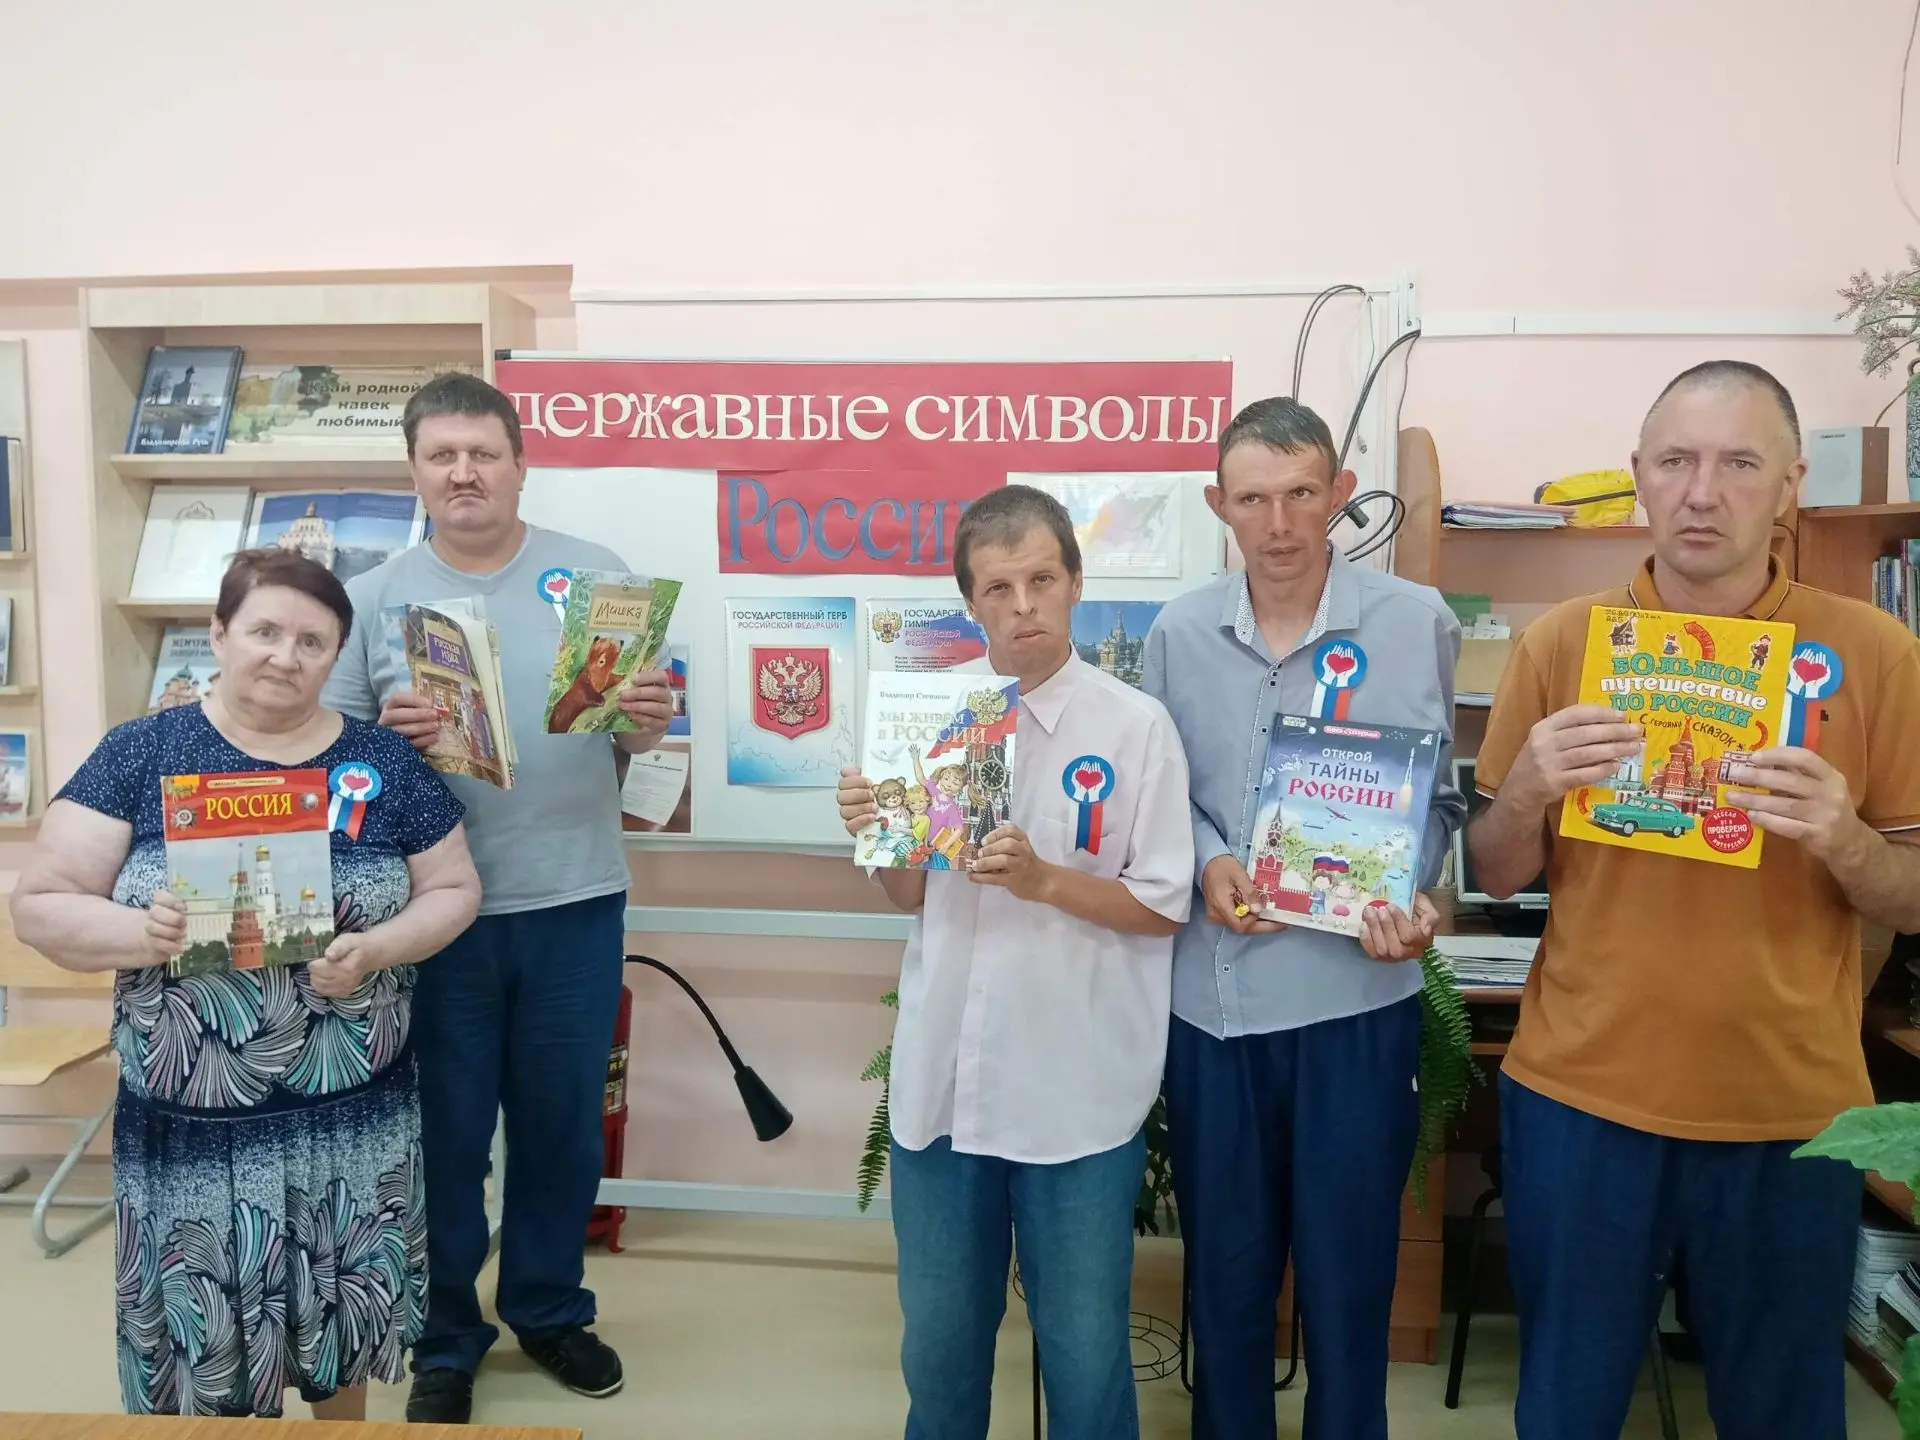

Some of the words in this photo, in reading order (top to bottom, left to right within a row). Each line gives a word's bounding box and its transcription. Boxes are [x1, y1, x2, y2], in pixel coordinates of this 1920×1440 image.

[310, 381, 350, 395] Край
[356, 382, 421, 396] родной
[338, 400, 390, 411] навек
[316, 415, 403, 428] любимый
[509, 391, 889, 441] державные
[905, 394, 1226, 443] символы
[595, 602, 642, 619] Мишка
[732, 610, 824, 621] ГОСУДАРСТВЕННЫЙ
[827, 611, 847, 621] ГЕРБ
[738, 620, 793, 630] РОССИЙСКОЙ
[795, 621, 843, 630] ФЕДЕРАЦИИ
[904, 620, 930, 629] ГИМН
[905, 629, 960, 639] РОССИЙСКОЙ
[1612, 653, 1761, 691] БОЛЬШОЕ
[880, 691, 914, 700] Владимир
[1600, 676, 1767, 711] путешествие
[1610, 693, 1645, 711] ПО
[1650, 693, 1753, 729] РОССИИ
[893, 725, 987, 744] РОССИИ
[1650, 719, 1682, 728] ГЕРОЯМИ
[1692, 721, 1737, 748] СКАЗОК
[1322, 747, 1372, 763] ОТКРОЙ
[1309, 762, 1380, 785] ТАЙНЫ
[1288, 778, 1396, 809] РОССИИ
[205, 793, 293, 820] РОССИЯ
[1707, 824, 1748, 834] ПРОВЕРЕНО
[1712, 837, 1745, 849] ИНТЕРЕСНО
